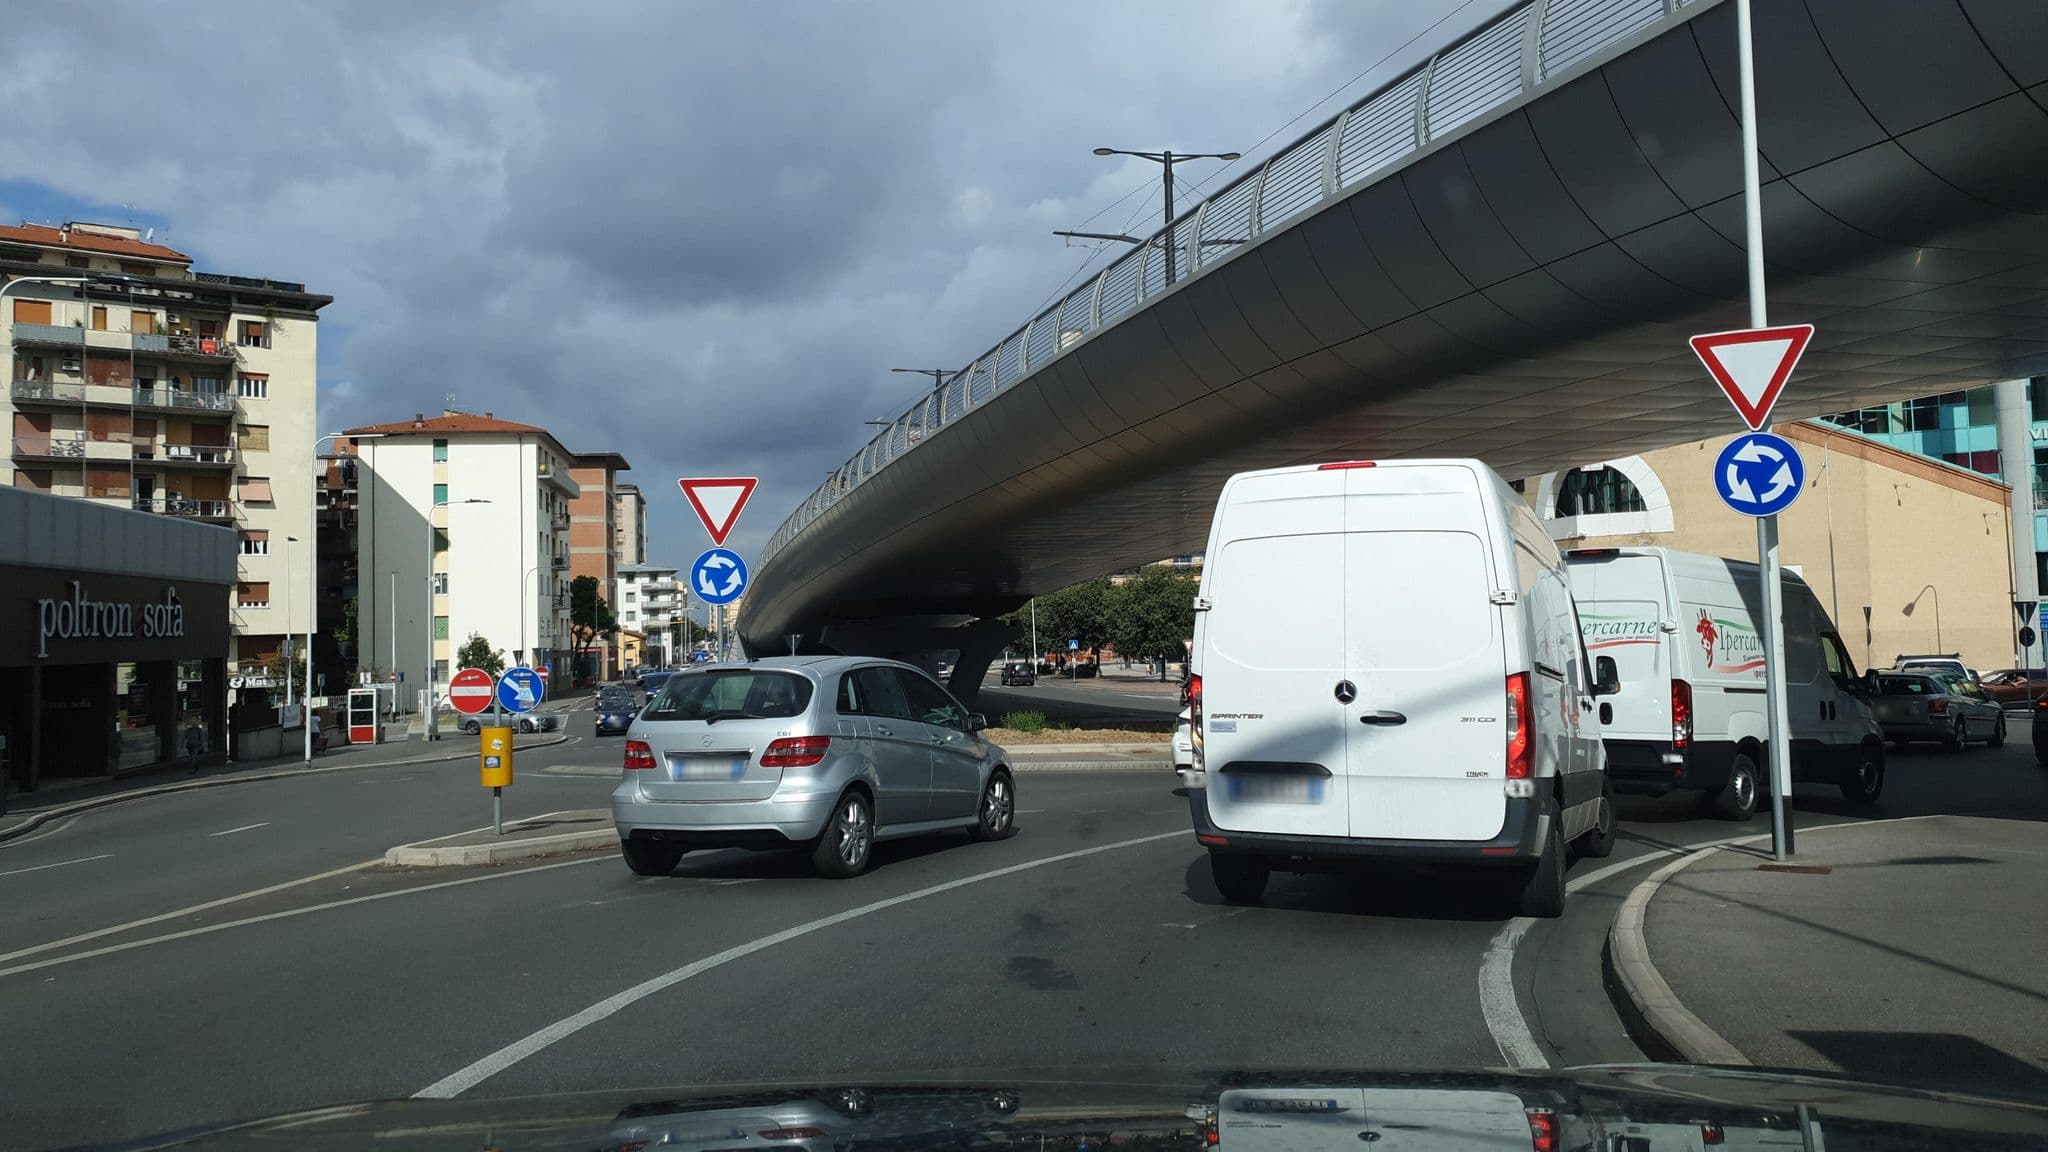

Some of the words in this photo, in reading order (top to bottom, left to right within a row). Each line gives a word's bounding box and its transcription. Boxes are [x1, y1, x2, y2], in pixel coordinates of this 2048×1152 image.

[1583, 621, 1657, 635] ercarne
[1718, 625, 1763, 661] Ipercar
[229, 677, 244, 688] &
